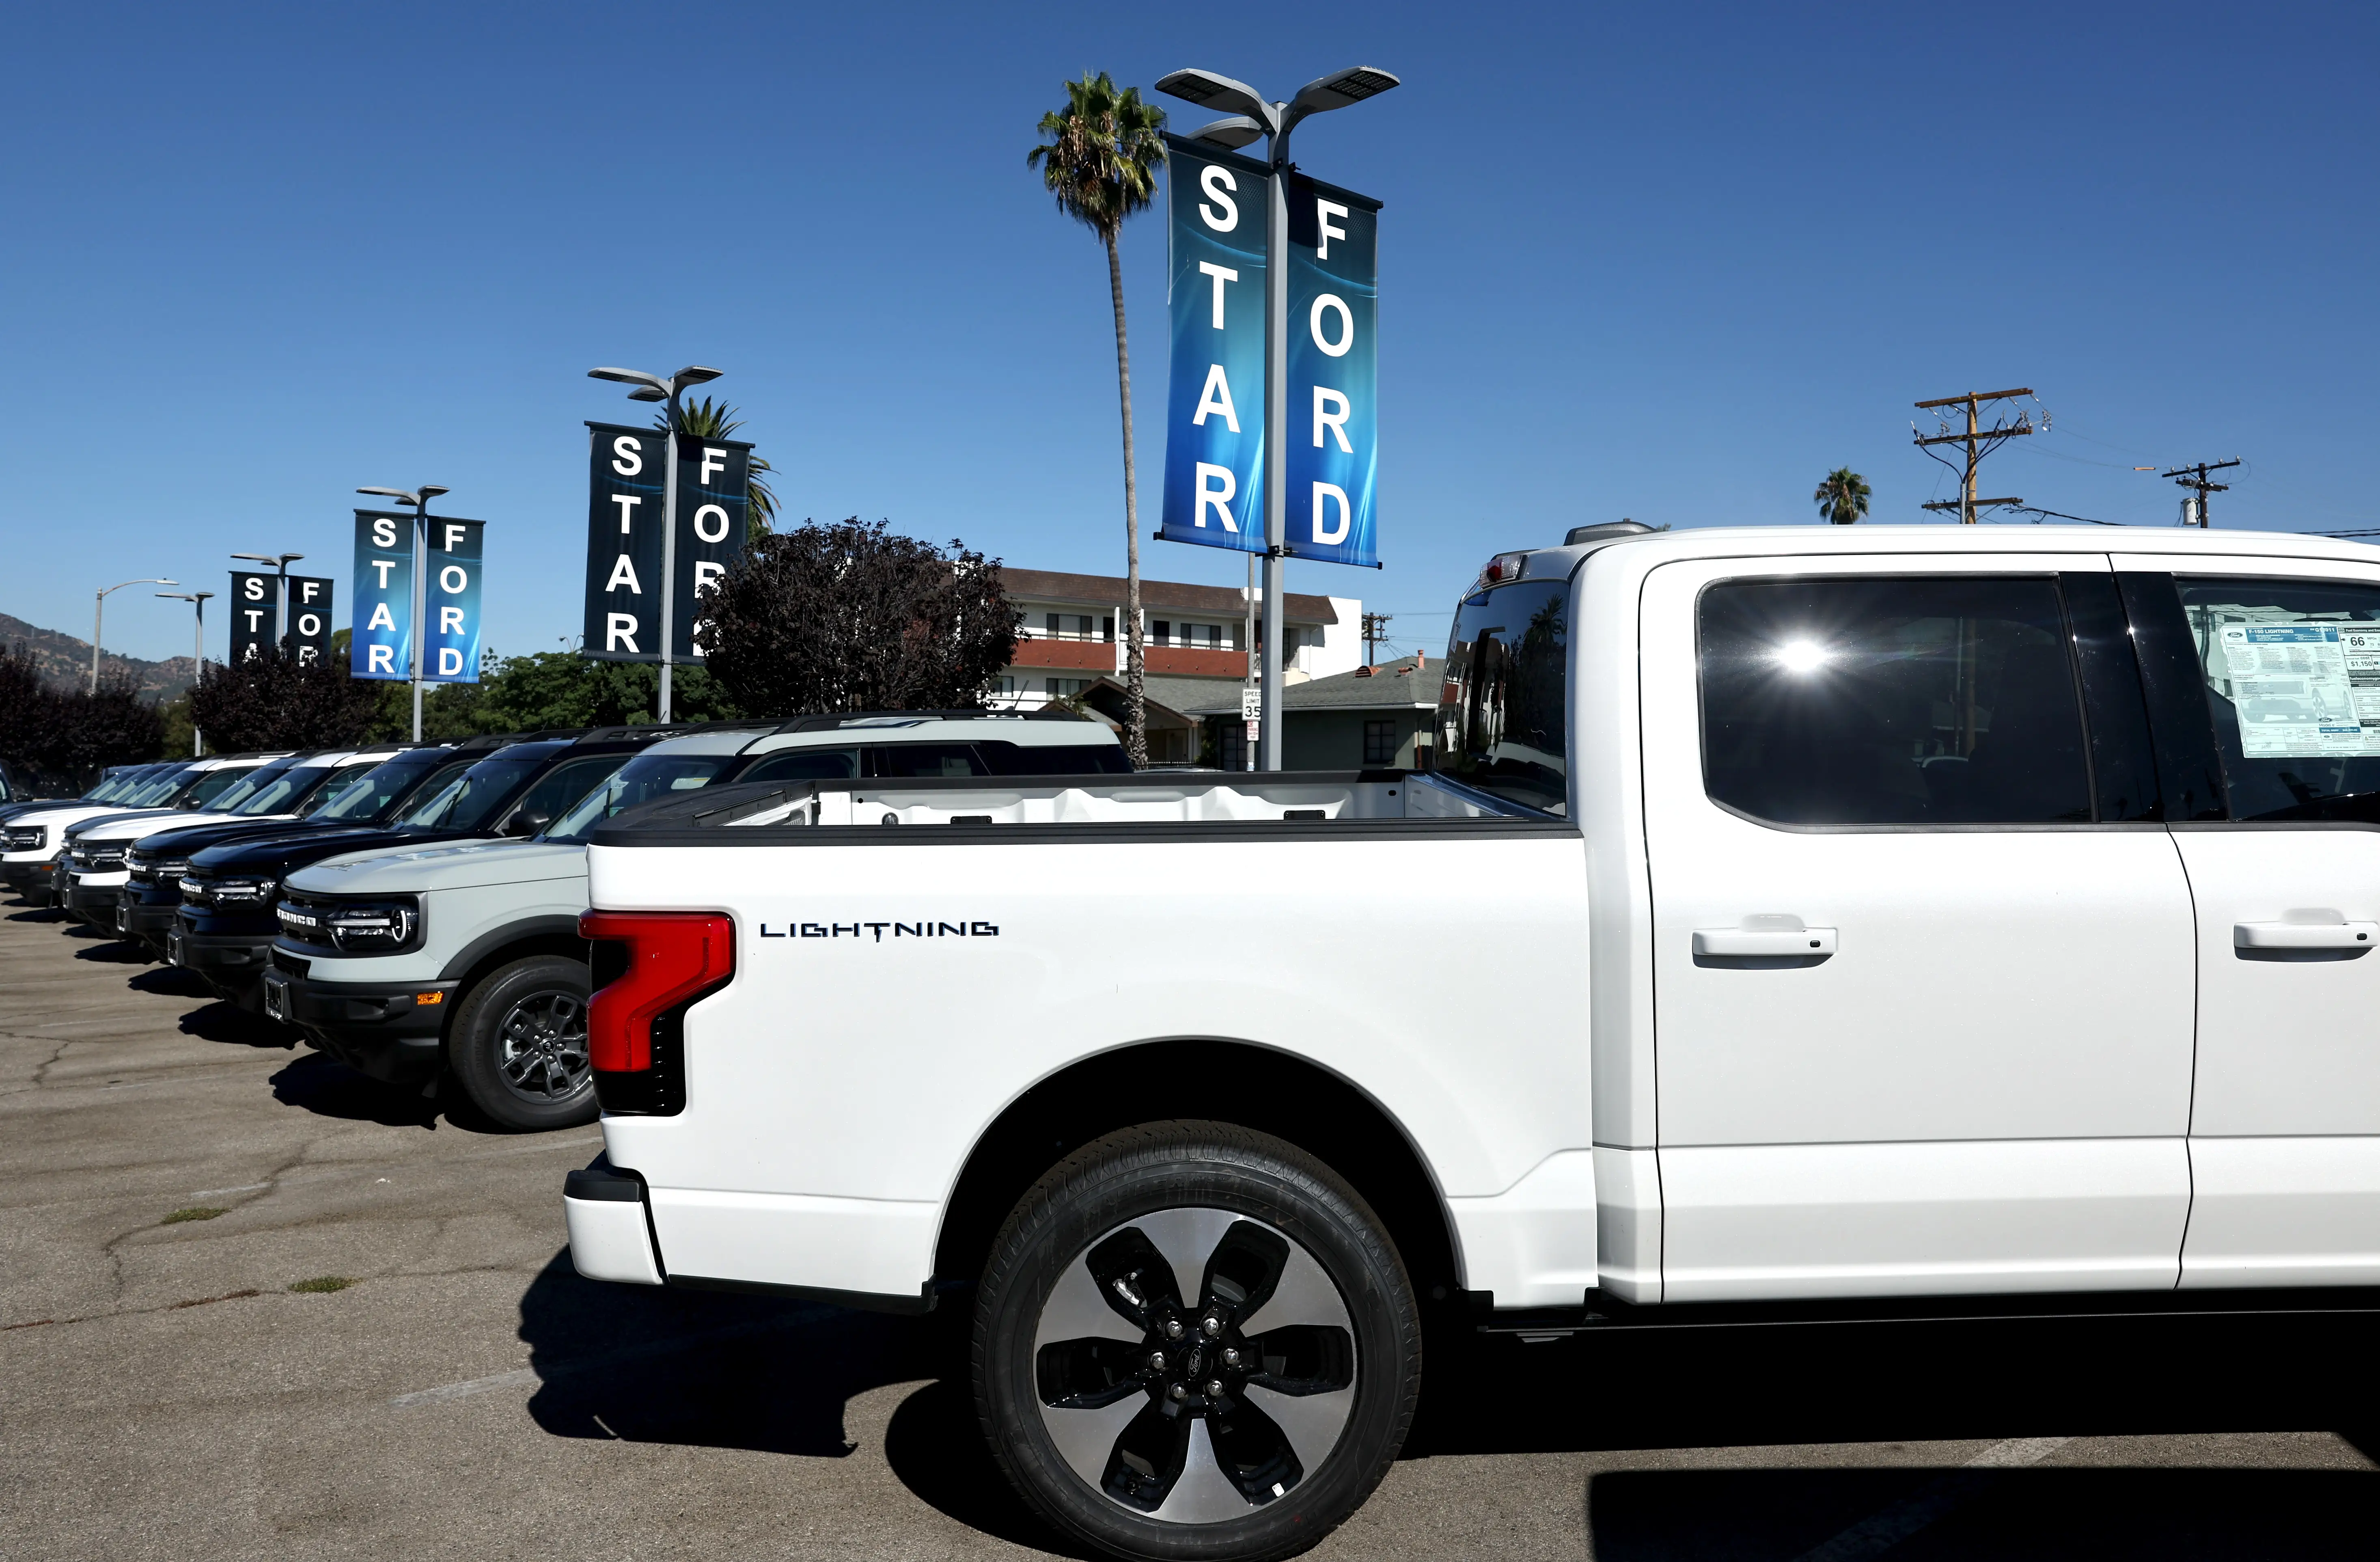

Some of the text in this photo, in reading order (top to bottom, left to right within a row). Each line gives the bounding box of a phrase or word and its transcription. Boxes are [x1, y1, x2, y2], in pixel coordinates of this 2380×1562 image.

[1192, 165, 1240, 533] STAR
[1310, 198, 1354, 546] FORD
[367, 518, 397, 673] STAR
[439, 524, 467, 676] FORD
[606, 436, 642, 653] STAR
[243, 577, 264, 666] STA
[298, 582, 321, 670] FOR
[2350, 636, 2365, 646] 66
[1245, 706, 1261, 717] 35
[760, 921, 999, 943] LIGHTNING
